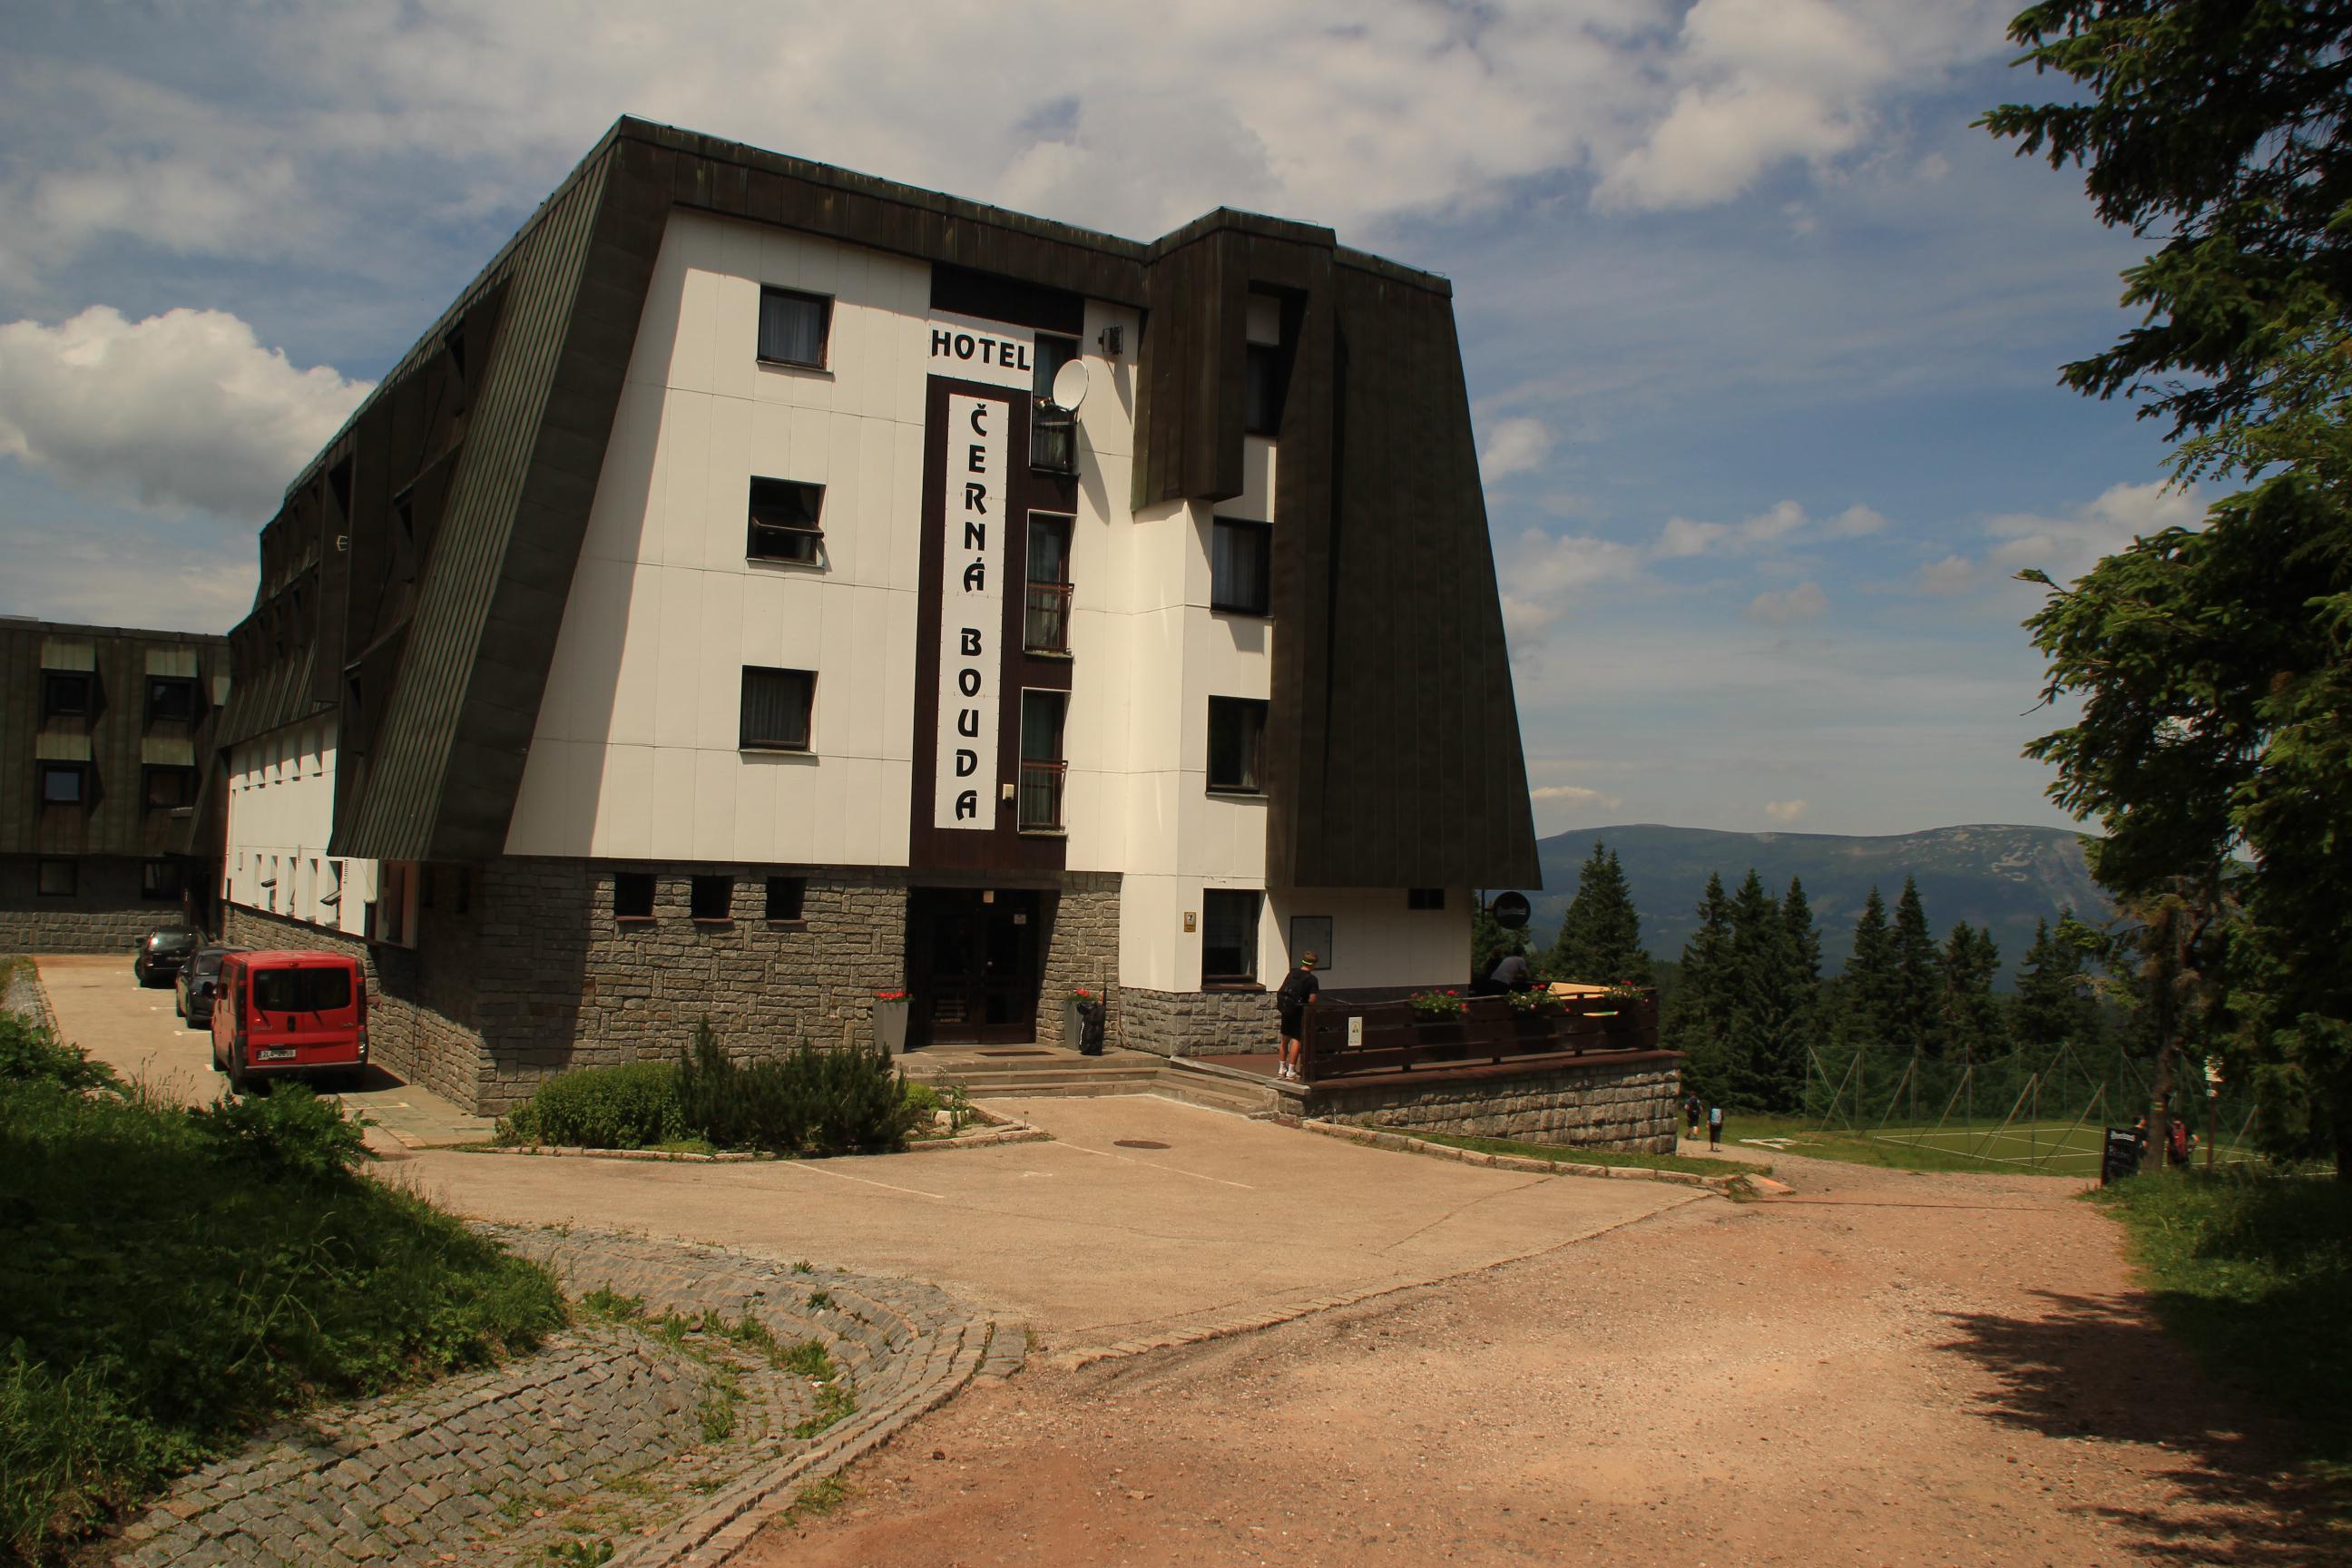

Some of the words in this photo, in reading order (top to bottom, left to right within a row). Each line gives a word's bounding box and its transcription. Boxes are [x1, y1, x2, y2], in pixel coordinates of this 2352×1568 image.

[931, 329, 1031, 371] HOTEL
[963, 403, 987, 593] ČERNÁ
[956, 627, 982, 821] BOUDA
